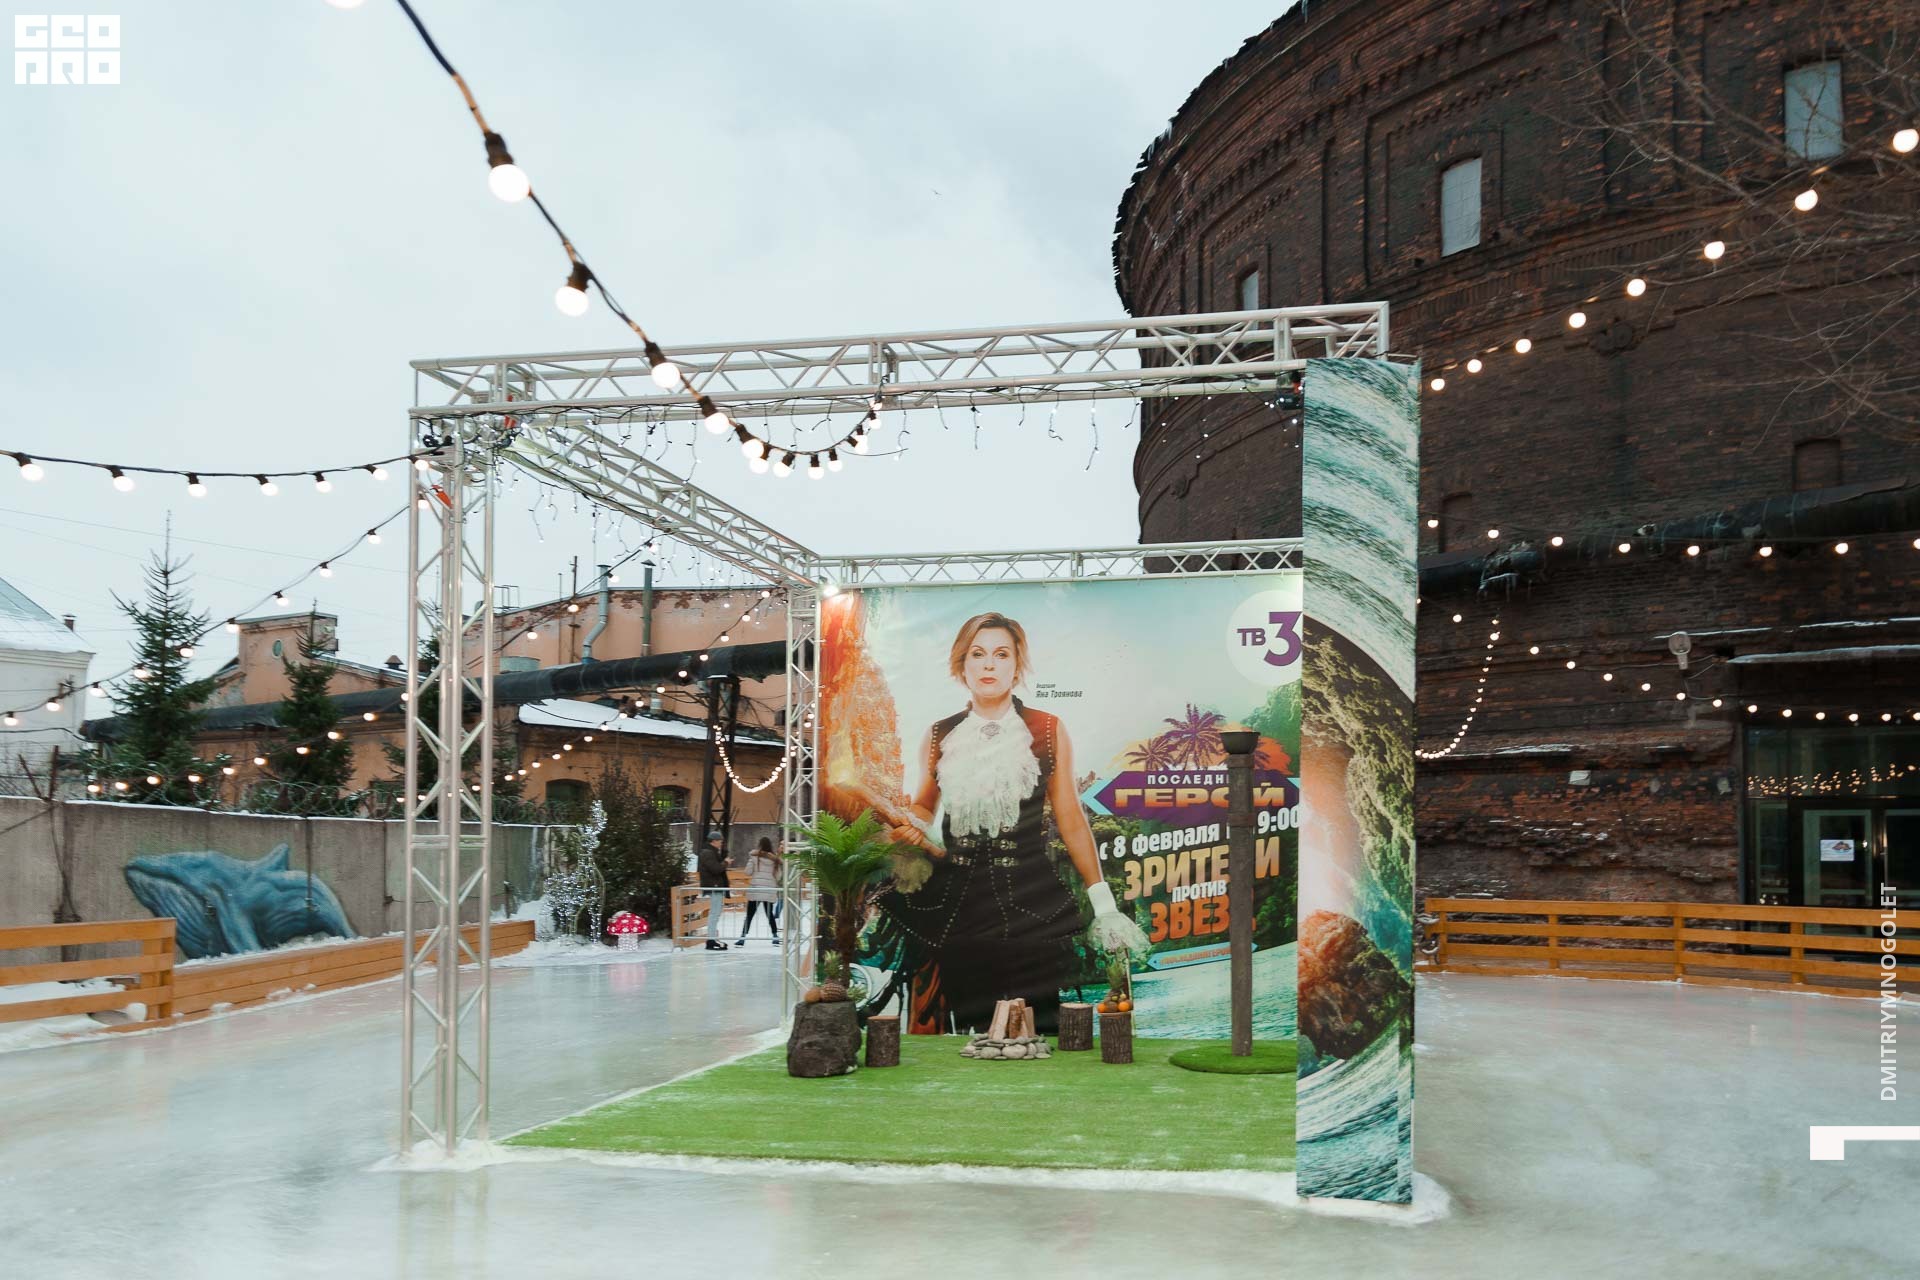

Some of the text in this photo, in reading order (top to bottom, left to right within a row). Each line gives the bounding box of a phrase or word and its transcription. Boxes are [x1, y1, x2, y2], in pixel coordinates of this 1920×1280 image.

[1147, 774, 1229, 785] ПОСЛЕДН
[1113, 835, 1126, 858] 8
[1132, 823, 1220, 857] февраля
[1252, 805, 1300, 836] 9:00
[1124, 836, 1280, 900] ЗРИТЕИ
[1172, 880, 1227, 903] ПРОТИВ
[1150, 889, 1257, 943] ЗВЕЗ
